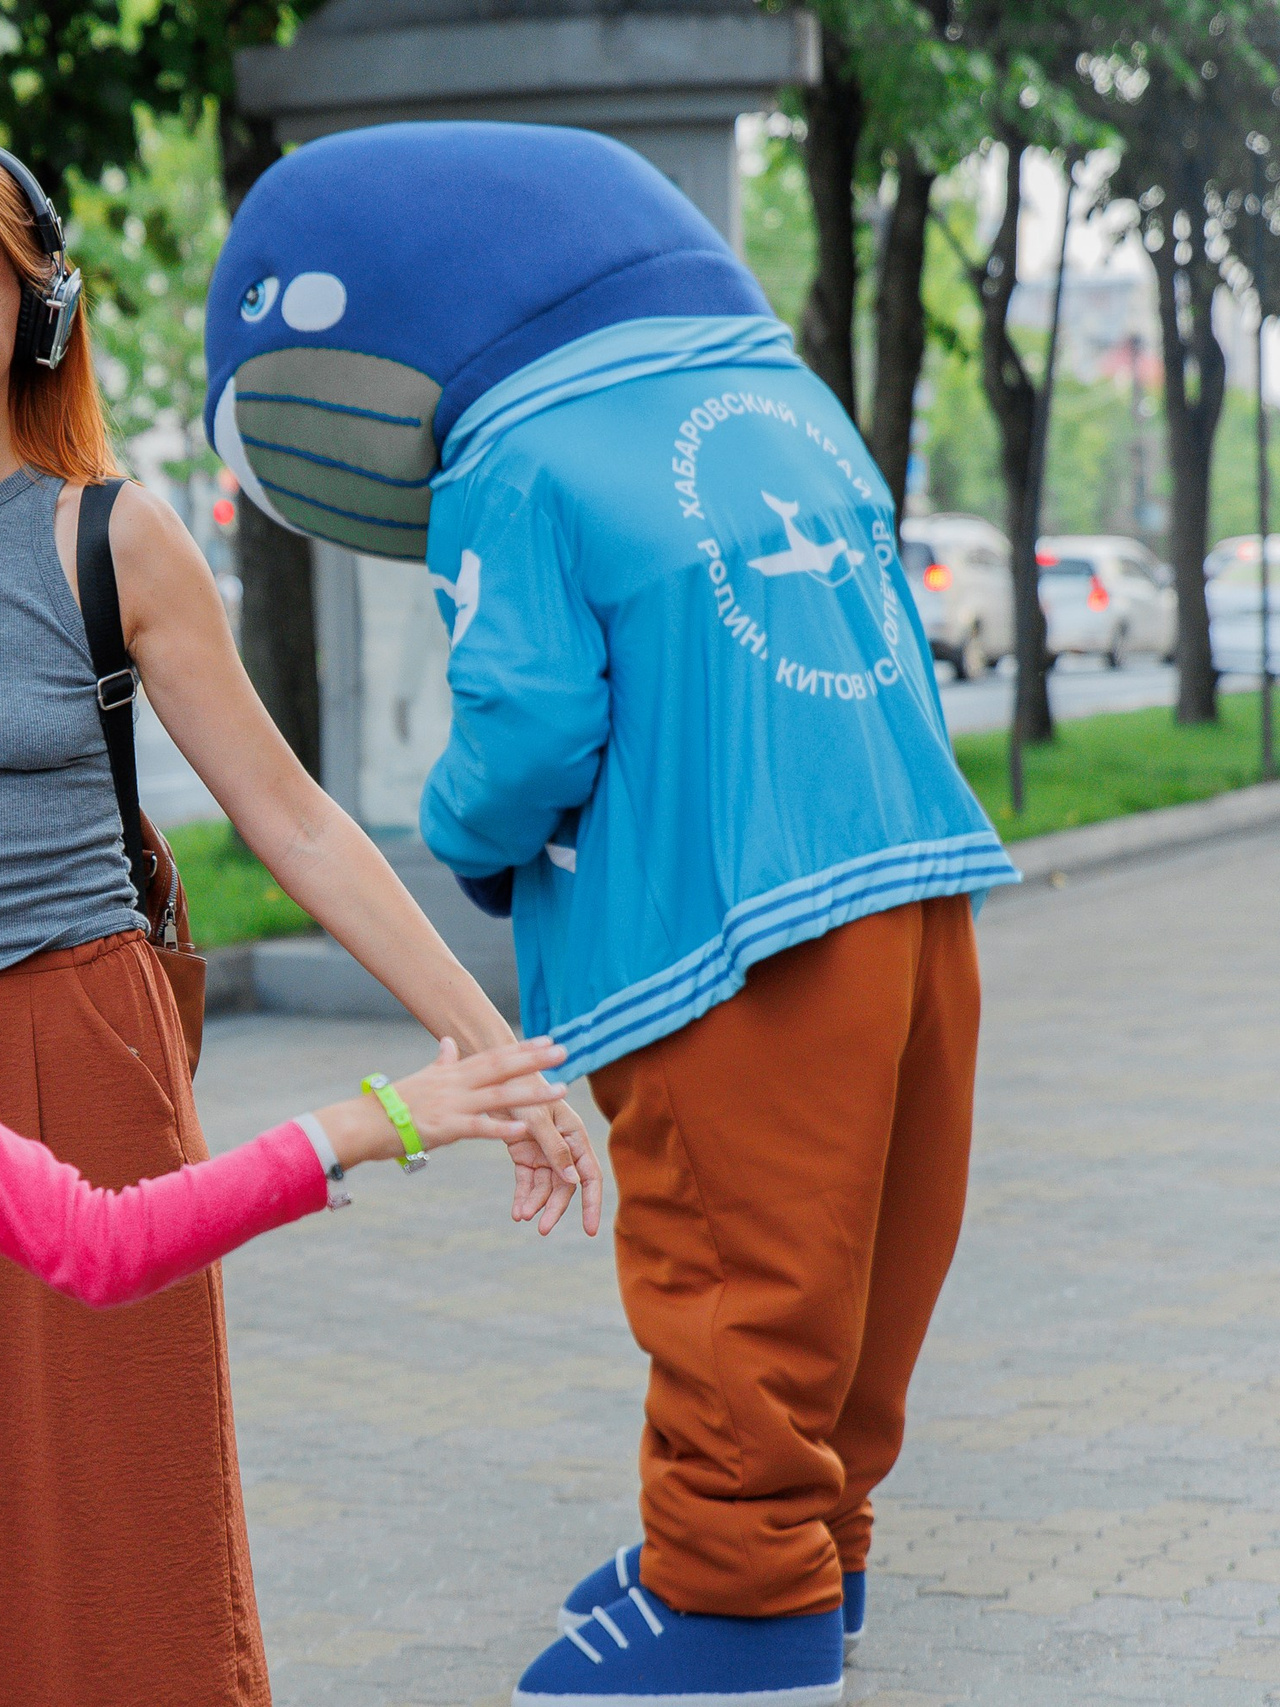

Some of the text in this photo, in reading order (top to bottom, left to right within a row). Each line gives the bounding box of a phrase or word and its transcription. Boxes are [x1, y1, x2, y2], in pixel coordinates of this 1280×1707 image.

[672, 392, 872, 520] ХАБАРОВСКИЙ КРАЙ
[775, 657, 867, 700] КИТОВ
